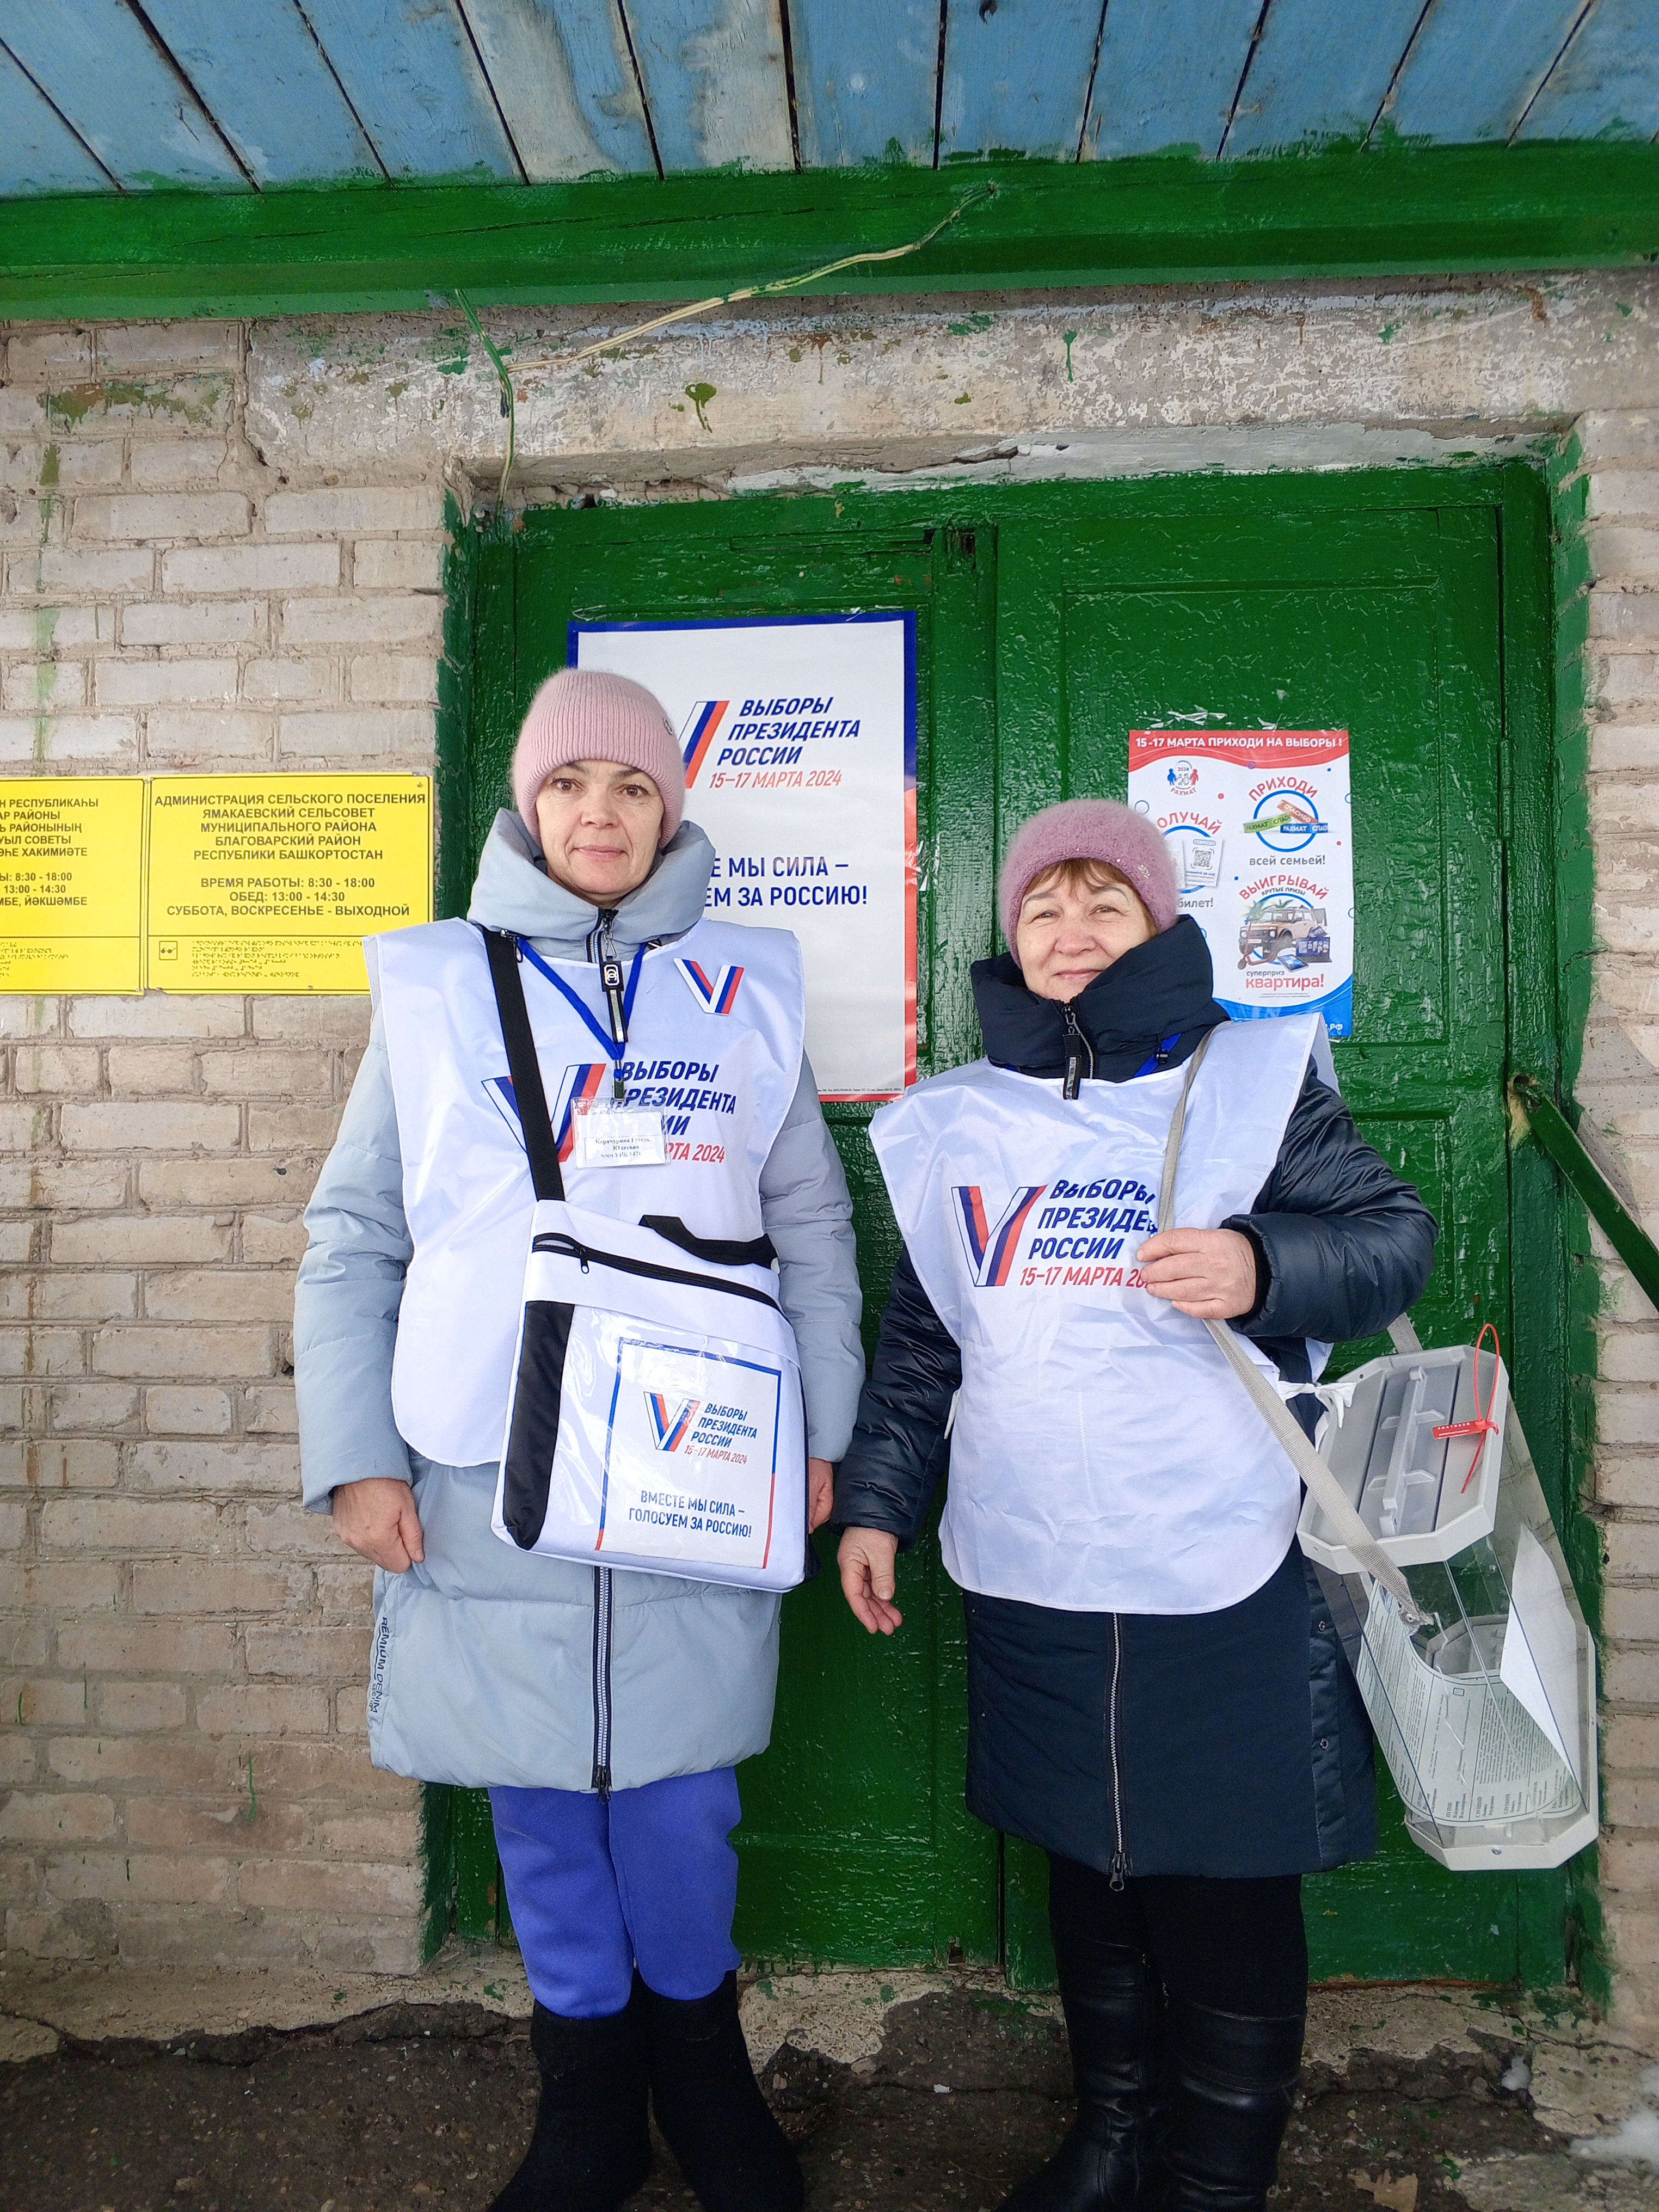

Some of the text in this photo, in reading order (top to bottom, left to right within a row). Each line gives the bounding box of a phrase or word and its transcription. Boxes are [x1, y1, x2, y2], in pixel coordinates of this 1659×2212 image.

[739, 697, 834, 717] ВЫБОРЫ
[728, 720, 861, 741] ПРЕЗИДЕНТА
[1167, 738, 1205, 747] МАРТА
[1208, 738, 1263, 749] ПРИХОДИ
[1267, 738, 1283, 747] НА
[1286, 738, 1335, 747] ВЫБОРЫ
[717, 746, 803, 766] РОССИИ
[752, 771, 803, 788] МАРТА
[806, 770, 842, 787] 2024
[1170, 787, 1196, 796] РАХМАТ
[1248, 776, 1318, 801] ПРИХОДИ
[155, 794, 425, 807] АДМИНИСТРАЦИЯ СЕЛЬСКОГО ПОСЕЛЕНИЯ
[14, 809, 60, 820] РАЙОНЫ
[202, 806, 375, 818] ЯМАКАЕВСКИЙ СЕЛЬСОВЕТ
[201, 819, 377, 833] МУНИЦИПАЛЬНОГО РАЙОНА
[1157, 811, 1222, 834] ОЛУЧАЙ
[24, 835, 71, 844] СОВЕТЫ
[216, 833, 361, 846] БЛАГОВАРСКИЙ РАЙОН
[194, 850, 383, 860] РЕСПУБЛИКИ БАШКОРТОСТАН
[1249, 855, 1325, 865] всей семьей!
[729, 857, 765, 877] МЫ
[772, 856, 828, 877] СИЛА
[15, 872, 36, 881] 8:30
[46, 872, 72, 881] 18:00
[201, 878, 243, 887] ВРЕМЯ
[248, 877, 304, 887] РАБОТЫ:
[308, 878, 332, 887] 8:30
[344, 878, 374, 887] 18:00
[4, 885, 30, 894] 13:00
[40, 884, 66, 893] 14:30
[738, 887, 763, 906] ЗА
[770, 885, 867, 906] РОССИЮ!
[1239, 875, 1329, 900] ВЫИГРЫВАЙ
[230, 892, 268, 903] ОБЕД:
[272, 892, 302, 901] 13:00
[314, 892, 345, 901] 14:30
[167, 906, 227, 917] СУББОТА,
[231, 906, 324, 915] ВОСКРЕСЕНЬЕ
[335, 904, 409, 918] ВЫХОДНОЙ
[1246, 974, 1324, 991] квартира!
[622, 1061, 720, 1083] ВЫБОРЫ
[612, 1087, 736, 1114] РЕЗИДЕНТА
[692, 1144, 725, 1163] 2024
[1037, 1207, 1158, 1233] ПРЕЗИДЕ
[1028, 1238, 1125, 1259] РОССИИ
[1062, 1267, 1123, 1286] МАРТА
[704, 1403, 748, 1421] ВЫБОРЫ
[697, 1417, 757, 1439] ПРЕЗИДЕНТА
[690, 1431, 733, 1448] РОССИИ
[706, 1448, 731, 1461] МАРТА
[730, 1453, 747, 1465] 2024
[641, 1490, 685, 1509] ВМЕСТЕ
[688, 1497, 707, 1512] МЫ
[710, 1501, 735, 1517] СИЛА
[629, 1508, 752, 1538] ГОЛОСУЕМ ЗА РОССИЮ!
[371, 1617, 390, 1713] REMIUM DENIM
